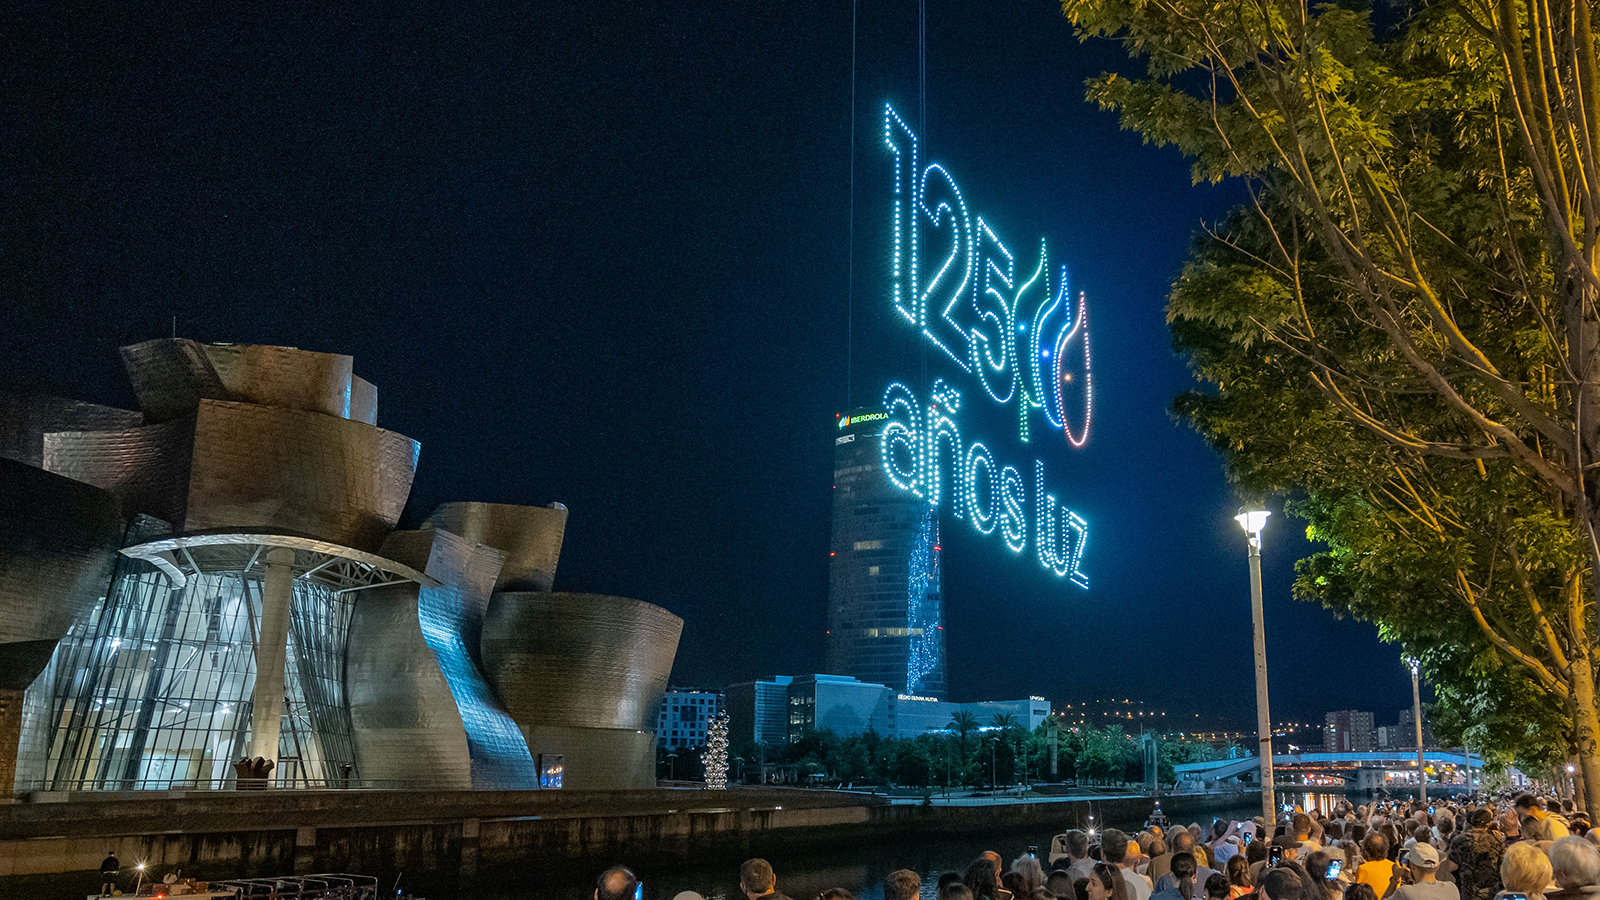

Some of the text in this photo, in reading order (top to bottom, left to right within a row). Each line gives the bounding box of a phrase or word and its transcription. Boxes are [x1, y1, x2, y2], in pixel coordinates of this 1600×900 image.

[884, 101, 1018, 403] 125
[850, 412, 889, 424] IBERDROLA
[880, 378, 1090, 590] años luz
